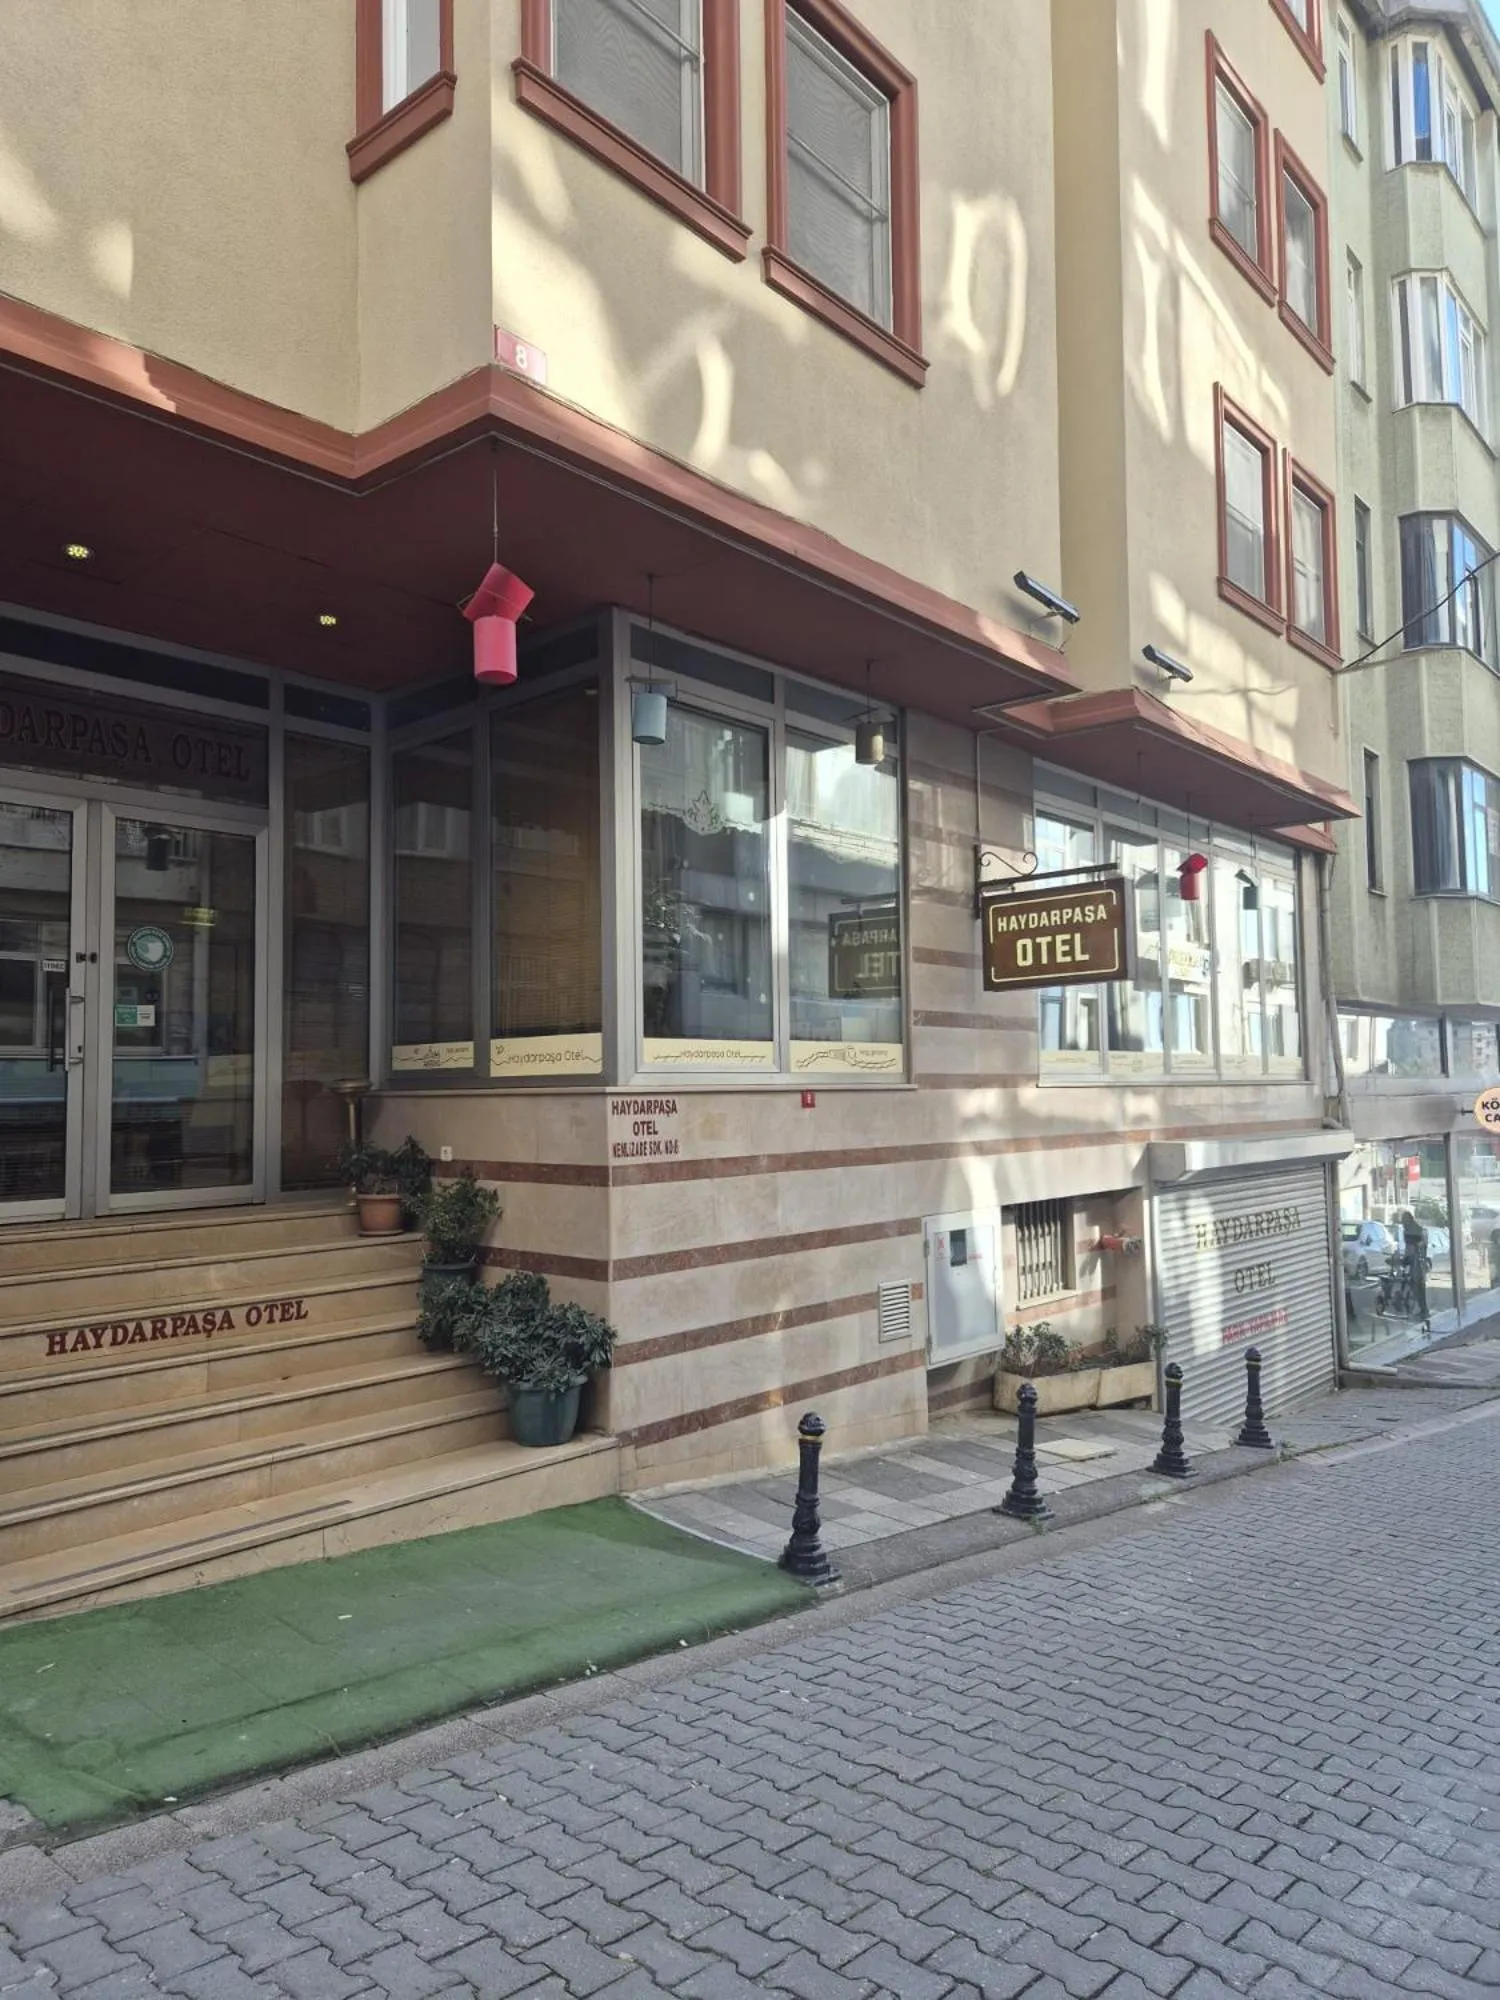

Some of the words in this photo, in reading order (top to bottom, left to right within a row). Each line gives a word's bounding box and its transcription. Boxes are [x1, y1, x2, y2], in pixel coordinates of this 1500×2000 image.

[515, 344, 528, 370] 8
[172, 732, 250, 782] OTEL
[997, 903, 1108, 933] HAYDARPAŞA
[1015, 932, 1090, 967] OTEL
[611, 1099, 678, 1117] HAYDARPAŞA
[632, 1120, 659, 1136] OTEL
[1196, 1206, 1301, 1250] HAYDARPAŞA
[1235, 1260, 1276, 1293] OTEL
[46, 1309, 235, 1357] HAYDARPAŞA
[245, 1300, 309, 1327] OTEL
